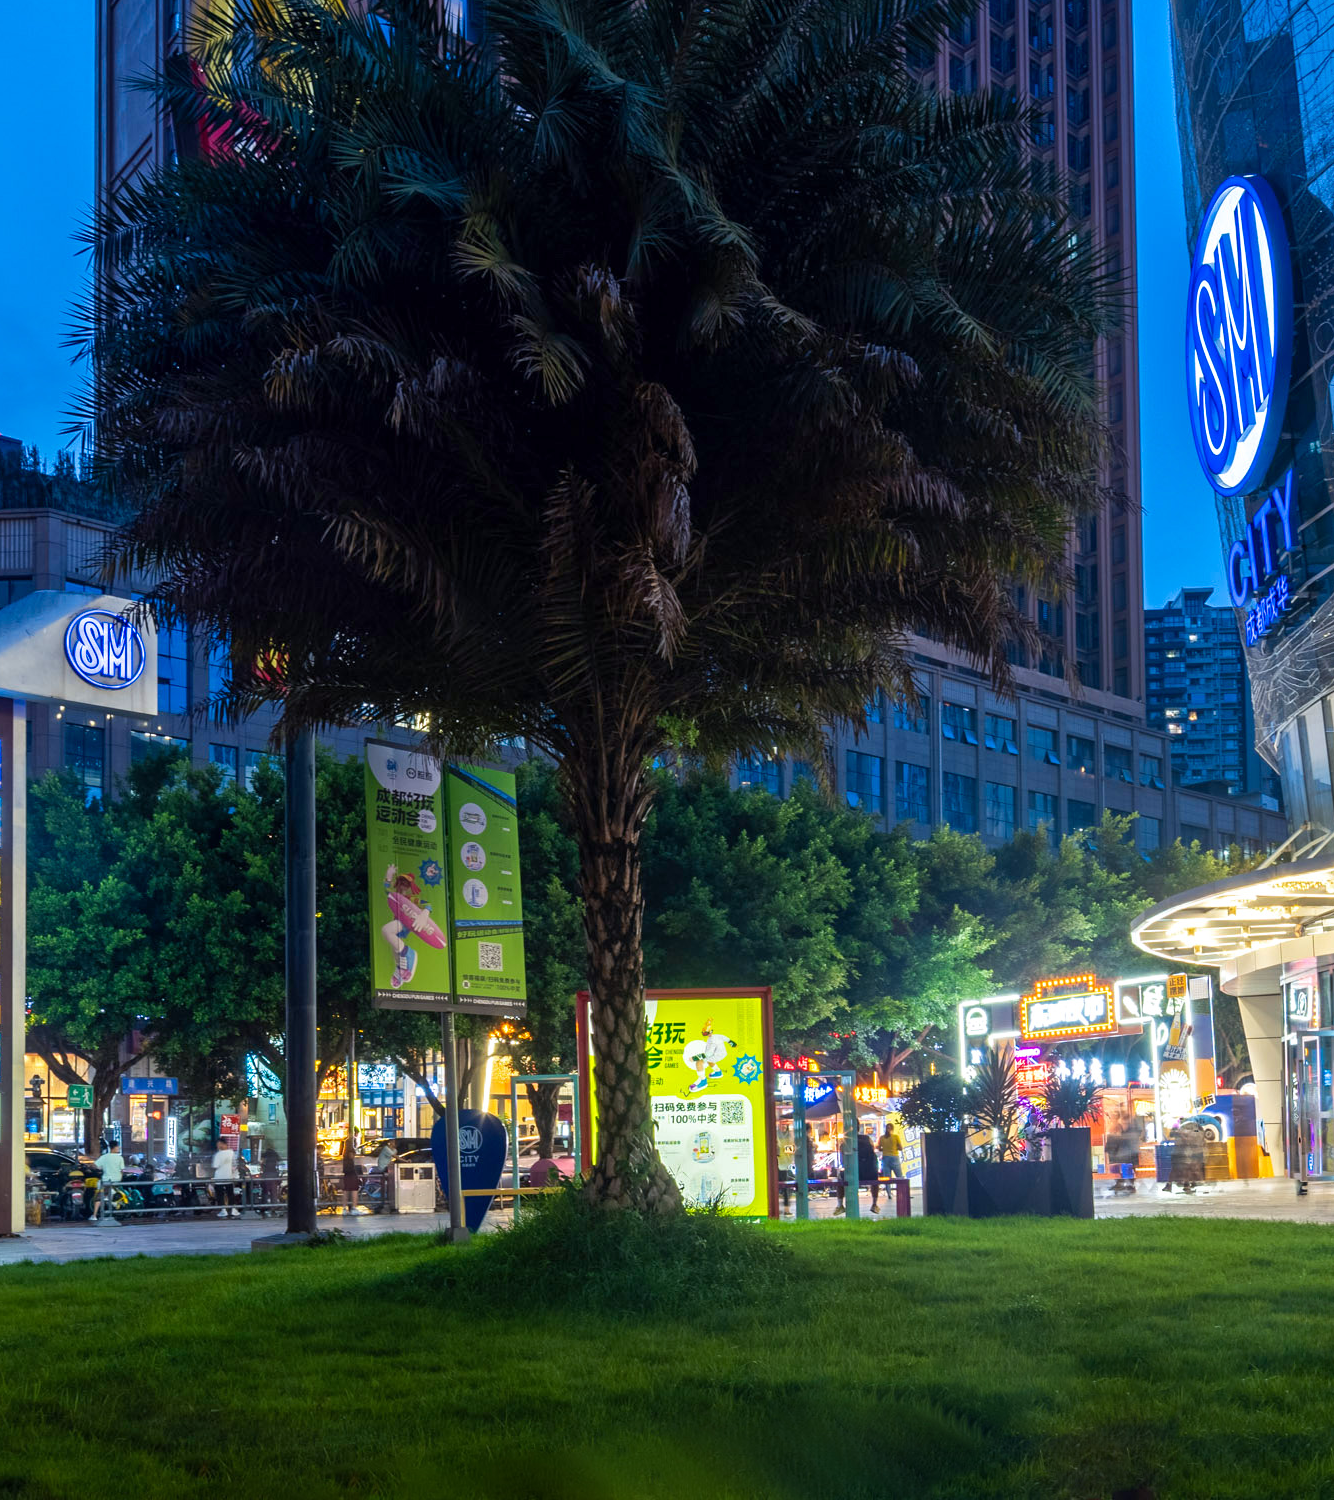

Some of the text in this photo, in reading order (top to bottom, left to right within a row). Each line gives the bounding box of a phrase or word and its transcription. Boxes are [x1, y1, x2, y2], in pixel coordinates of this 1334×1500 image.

[1189, 188, 1273, 476] SM
[1229, 467, 1293, 608] CITY
[1245, 574, 1289, 648] 成都成华
[73, 616, 133, 681] SM
[377, 787, 435, 812] 成都好玩
[376, 805, 421, 827] 运动会
[654, 1101, 718, 1113] 扫码免费参与
[671, 1113, 718, 1125] 100%中奖
[459, 1128, 479, 1150] SM
[459, 1155, 480, 1163] CITY
